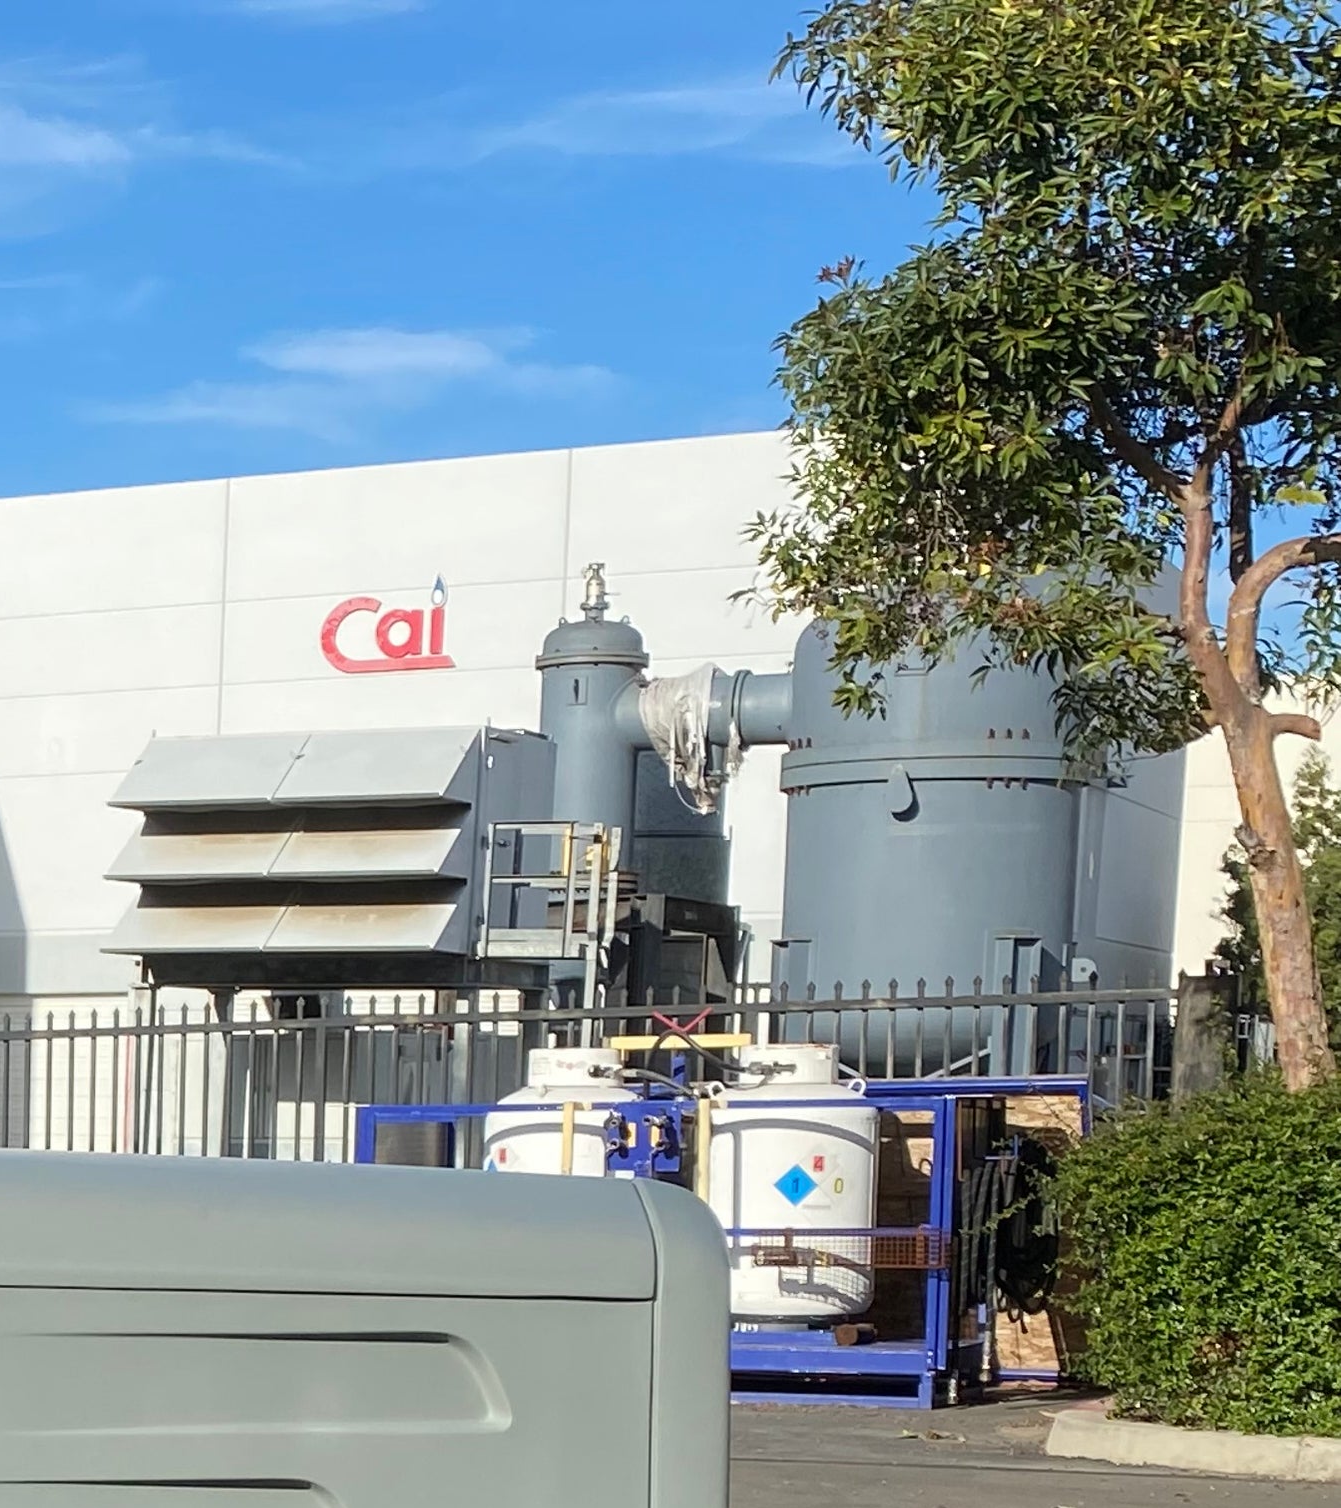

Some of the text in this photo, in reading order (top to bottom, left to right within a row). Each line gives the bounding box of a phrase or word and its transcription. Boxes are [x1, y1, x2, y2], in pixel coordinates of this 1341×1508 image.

[812, 1156, 824, 1172] 4
[792, 1178, 799, 1194] 1
[834, 1177, 844, 1194] 0
